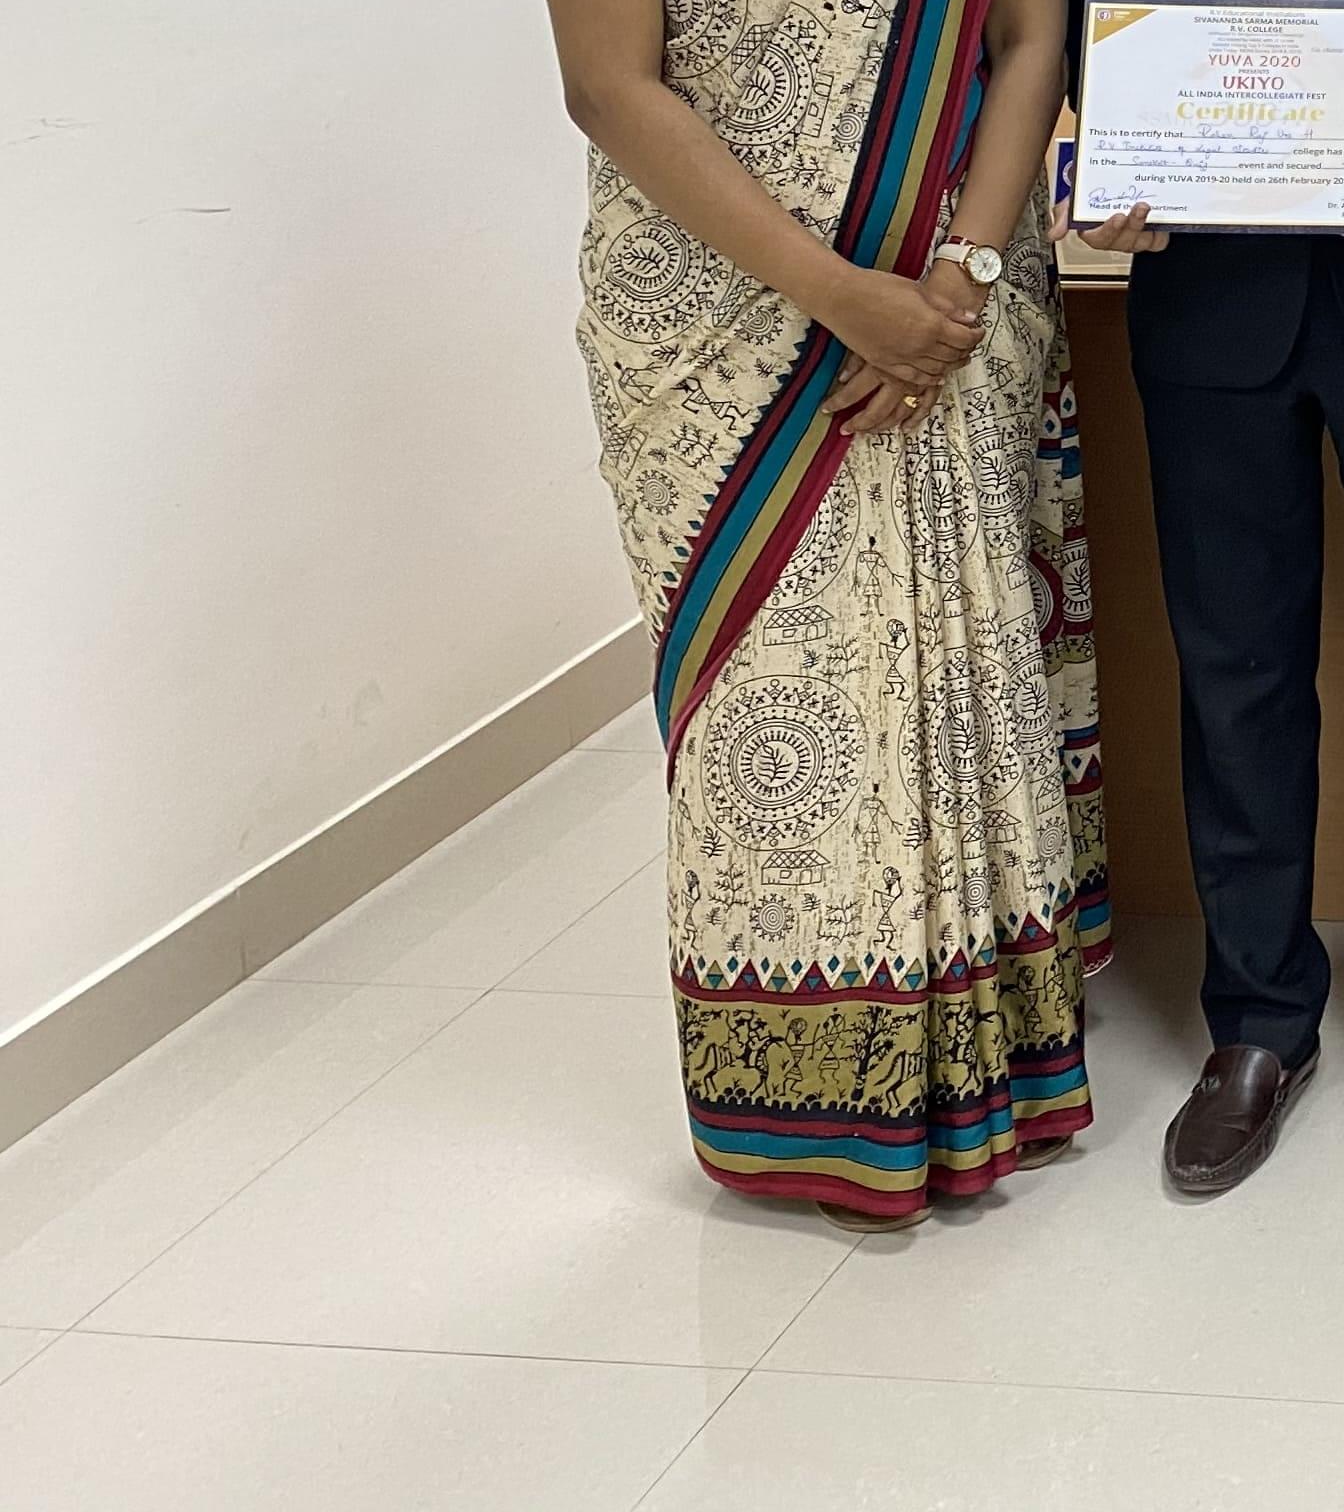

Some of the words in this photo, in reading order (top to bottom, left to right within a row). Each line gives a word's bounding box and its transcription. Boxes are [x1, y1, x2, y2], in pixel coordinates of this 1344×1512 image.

[1208, 54, 1253, 66] YUVA
[1259, 55, 1301, 67] 2020
[1222, 75, 1284, 89] UKIYO
[1196, 90, 1222, 98] INDIA
[1224, 91, 1303, 99] INTERCOLLEGIATE
[1175, 100, 1325, 122] Certificate
[1088, 129, 1107, 137] This
[1110, 129, 1117, 137] is
[1131, 129, 1162, 139] certify
[1164, 130, 1183, 138] that
